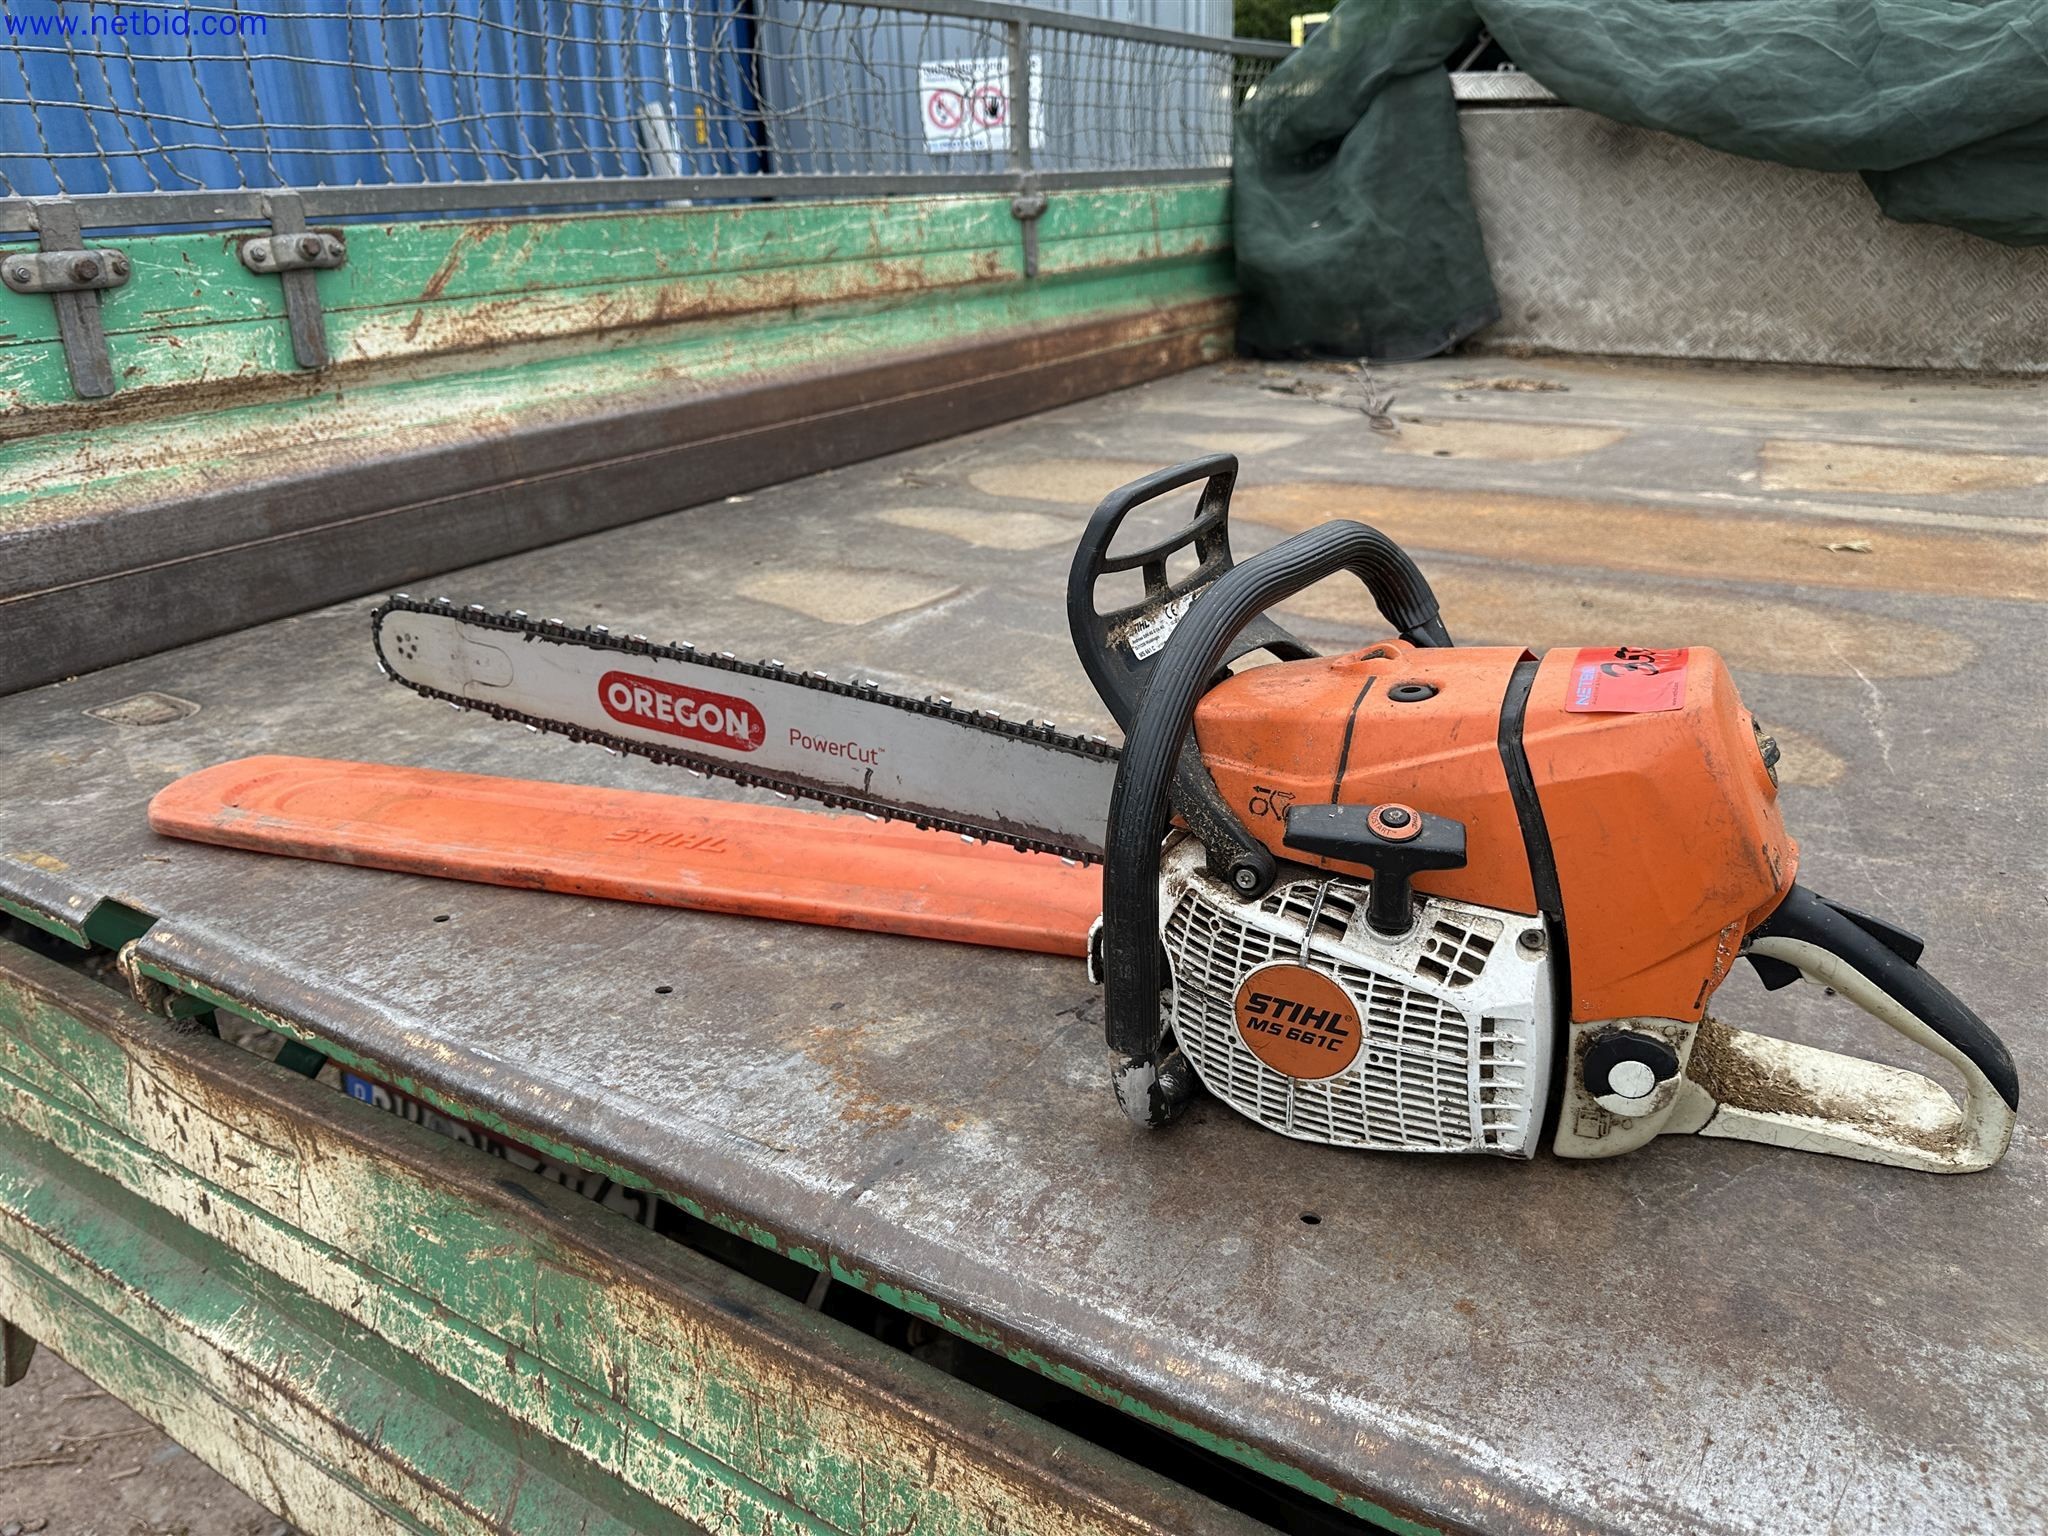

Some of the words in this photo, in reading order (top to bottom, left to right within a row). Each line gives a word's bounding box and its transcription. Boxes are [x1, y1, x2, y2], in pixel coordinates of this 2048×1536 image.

[605, 829, 727, 853] STIHL
[1246, 1016, 1284, 1036] MS
[1285, 1026, 1344, 1052] 661C
